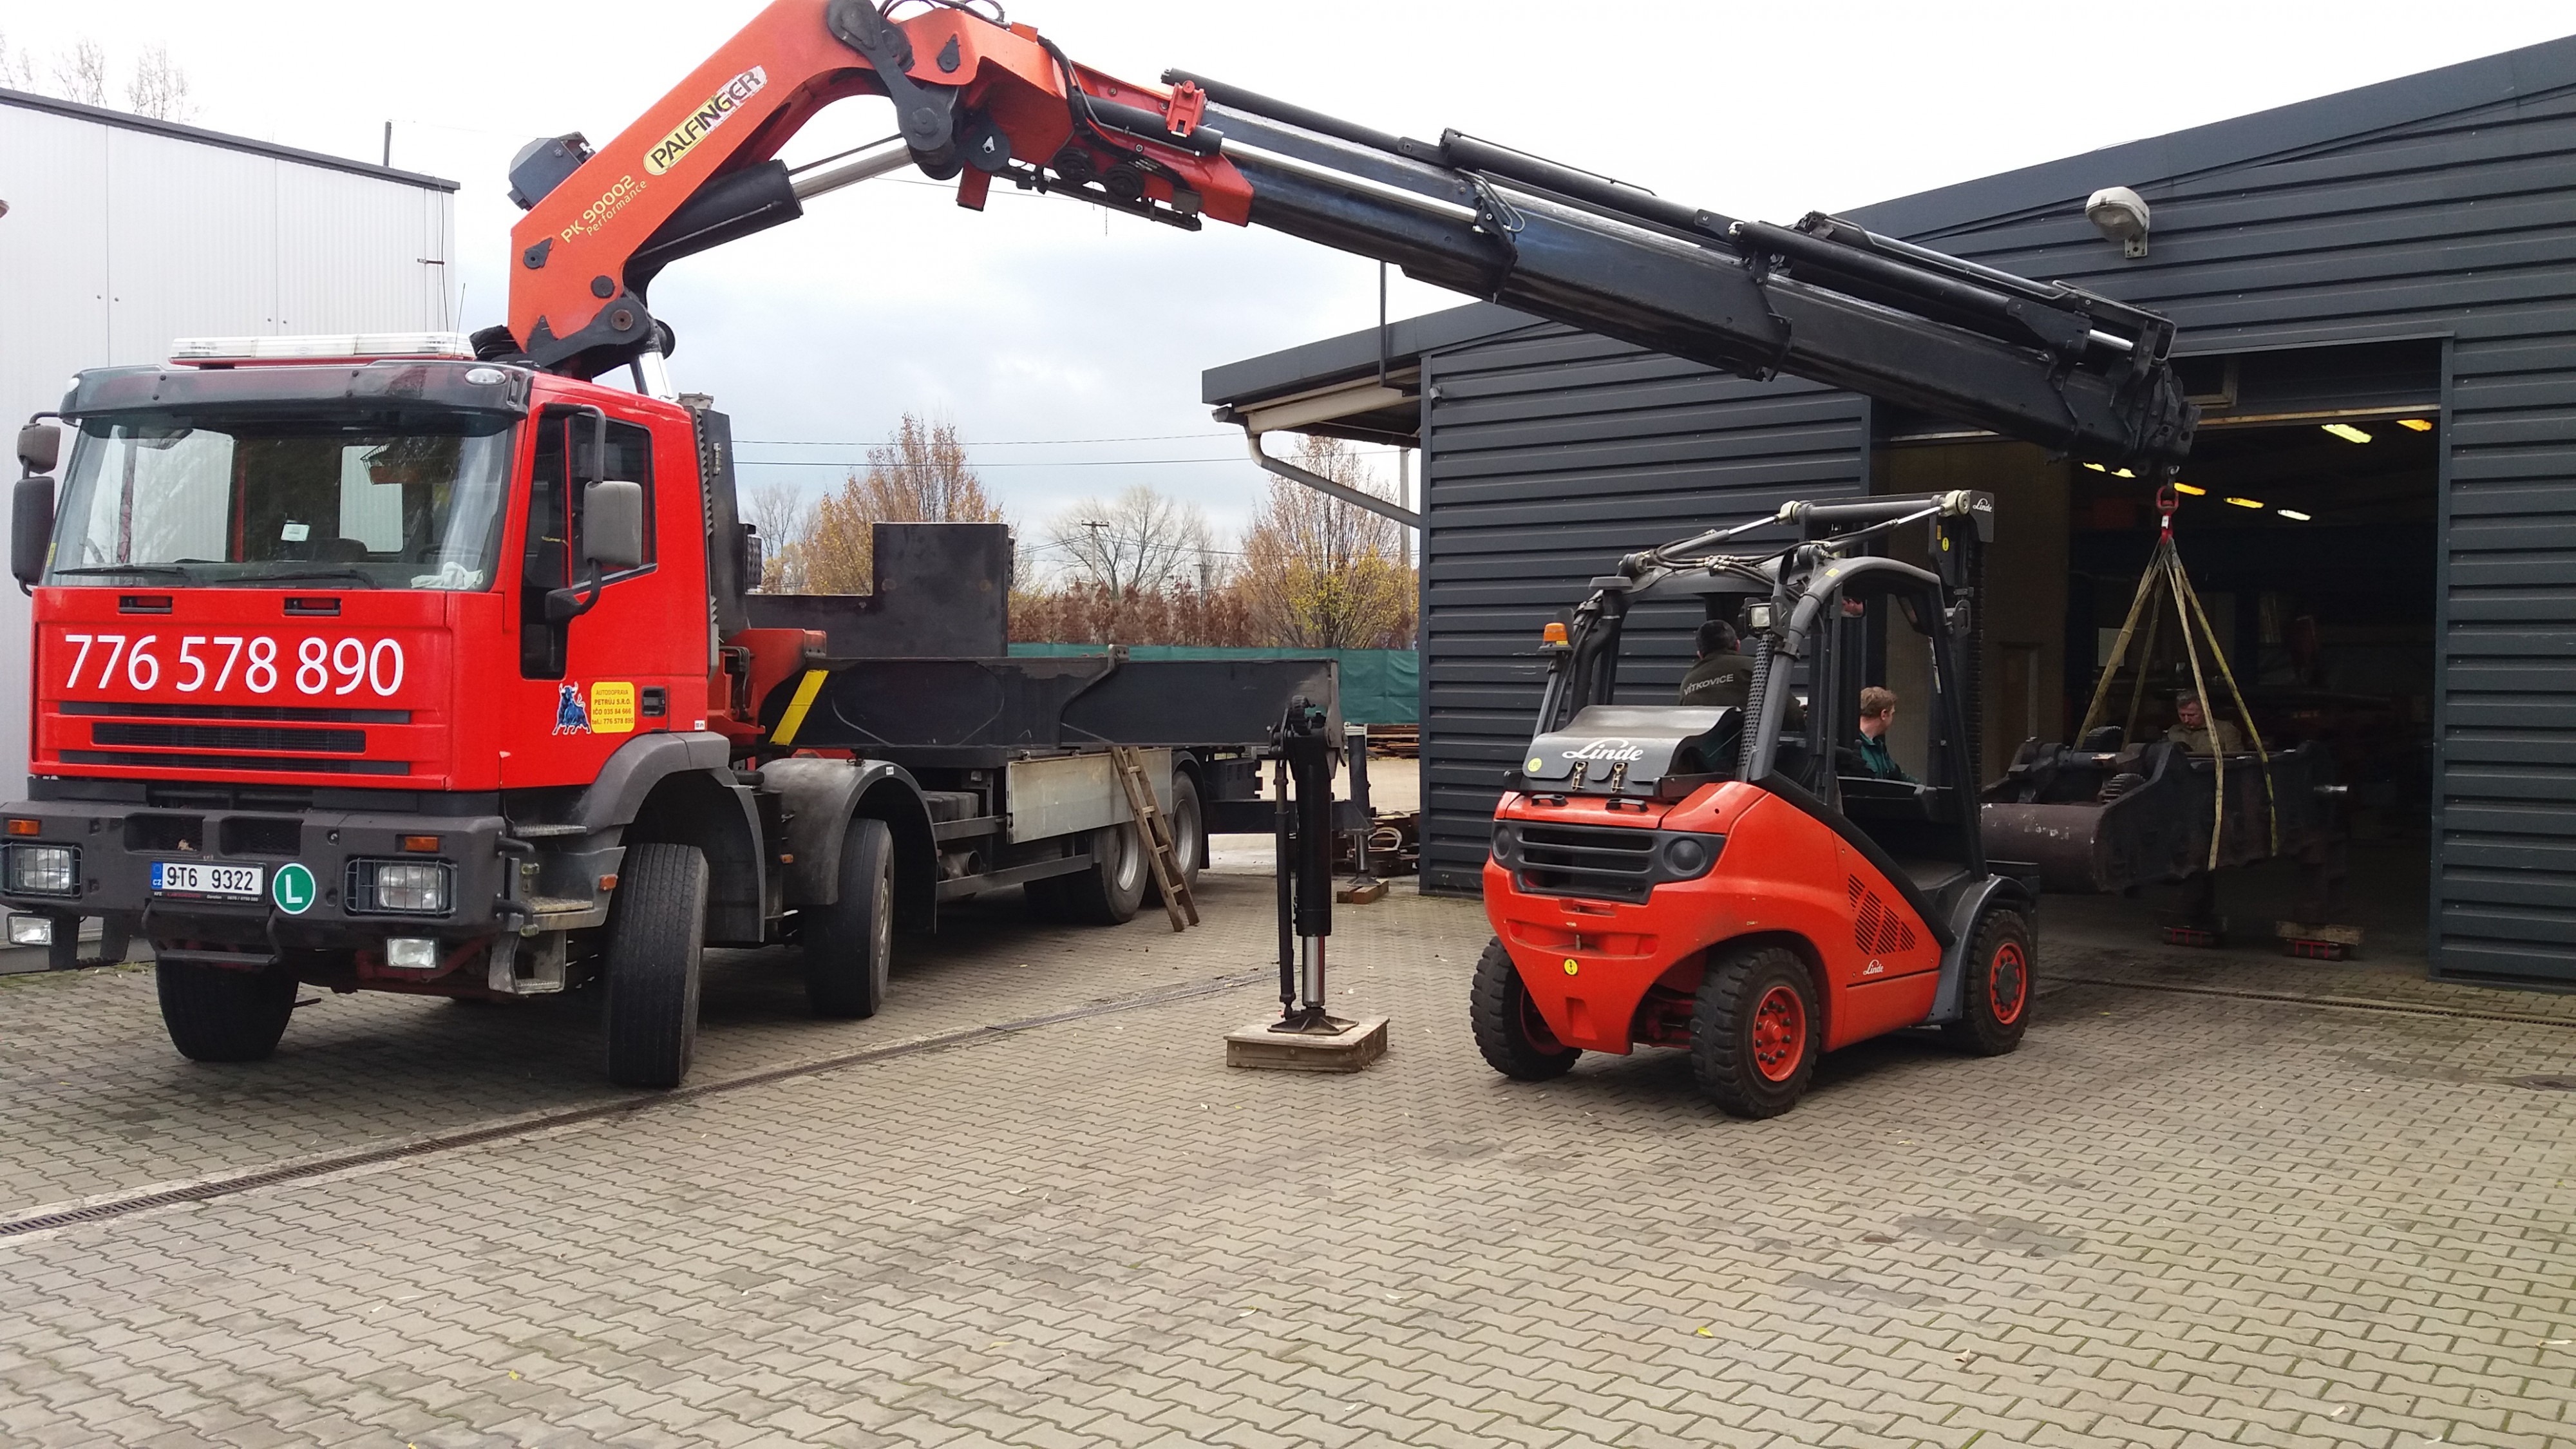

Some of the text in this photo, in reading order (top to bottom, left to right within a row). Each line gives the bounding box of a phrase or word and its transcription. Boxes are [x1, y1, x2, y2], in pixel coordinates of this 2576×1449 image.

[650, 71, 761, 169] PALFINGER
[560, 175, 636, 243] PK 90002
[586, 180, 647, 236] Performance
[1972, 498, 1993, 513] Linde
[65, 634, 404, 696] 776 578 890
[1562, 739, 1643, 761] Linde
[167, 866, 198, 887] 9T6
[211, 869, 253, 891] 9322
[285, 874, 303, 904] L
[1862, 959, 1884, 976] Linde
